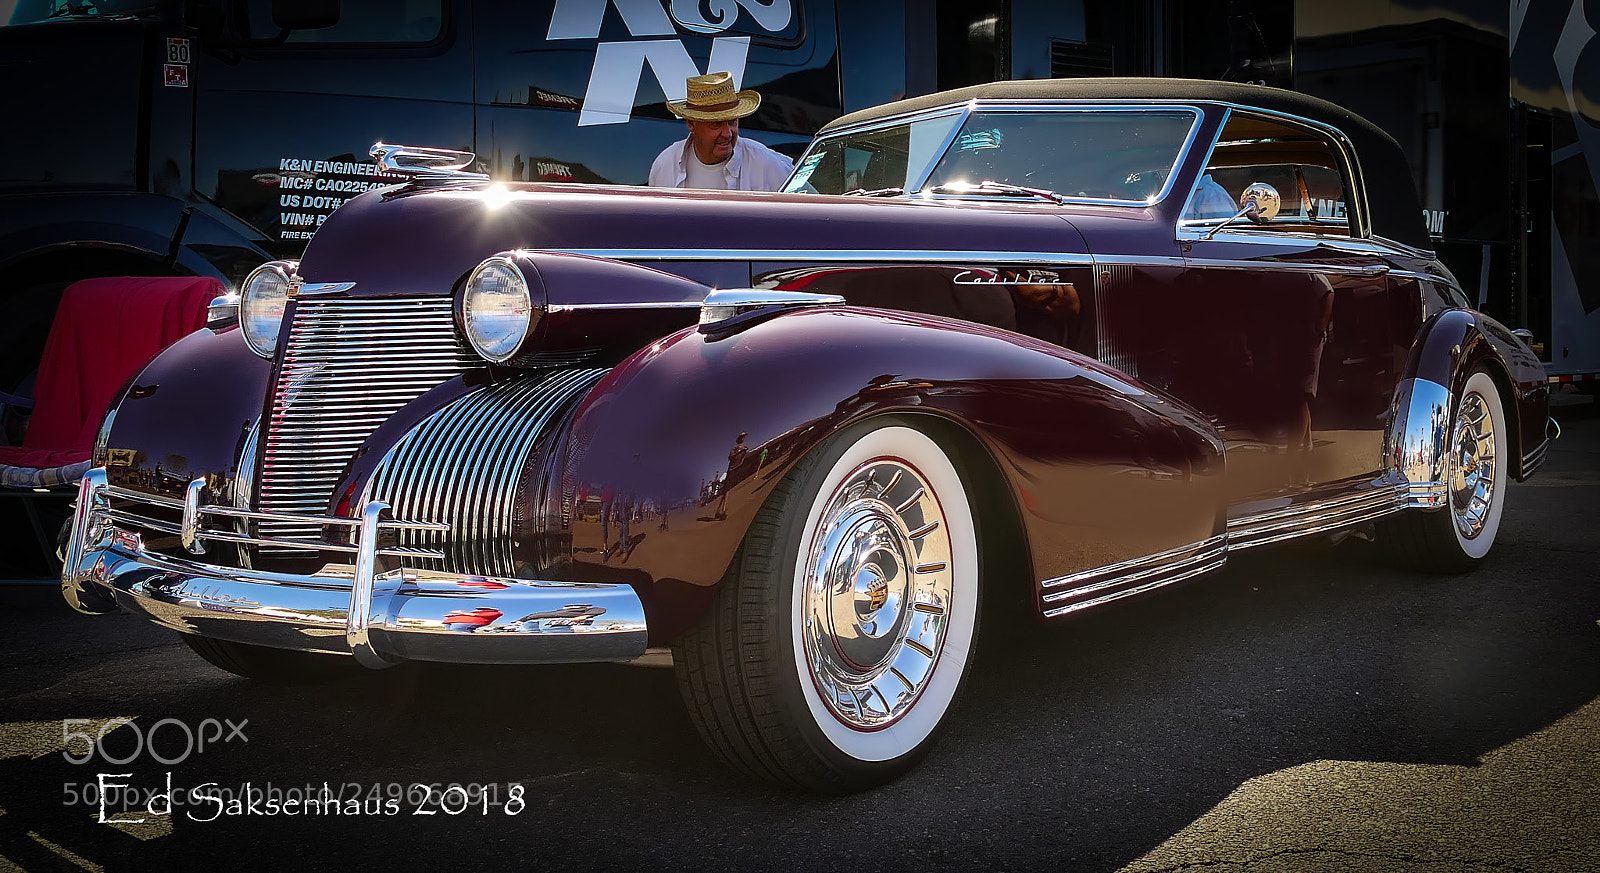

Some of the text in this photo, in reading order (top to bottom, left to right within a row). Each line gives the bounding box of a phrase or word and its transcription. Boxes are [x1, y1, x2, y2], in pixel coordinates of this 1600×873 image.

[279, 158, 313, 172] K&N
[279, 176, 392, 193] MC# CA02254
[280, 194, 301, 208] US
[302, 195, 342, 210] DOT#
[280, 212, 315, 226] VIN#
[280, 230, 300, 239] FIRE
[953, 270, 1074, 286] Cadillac
